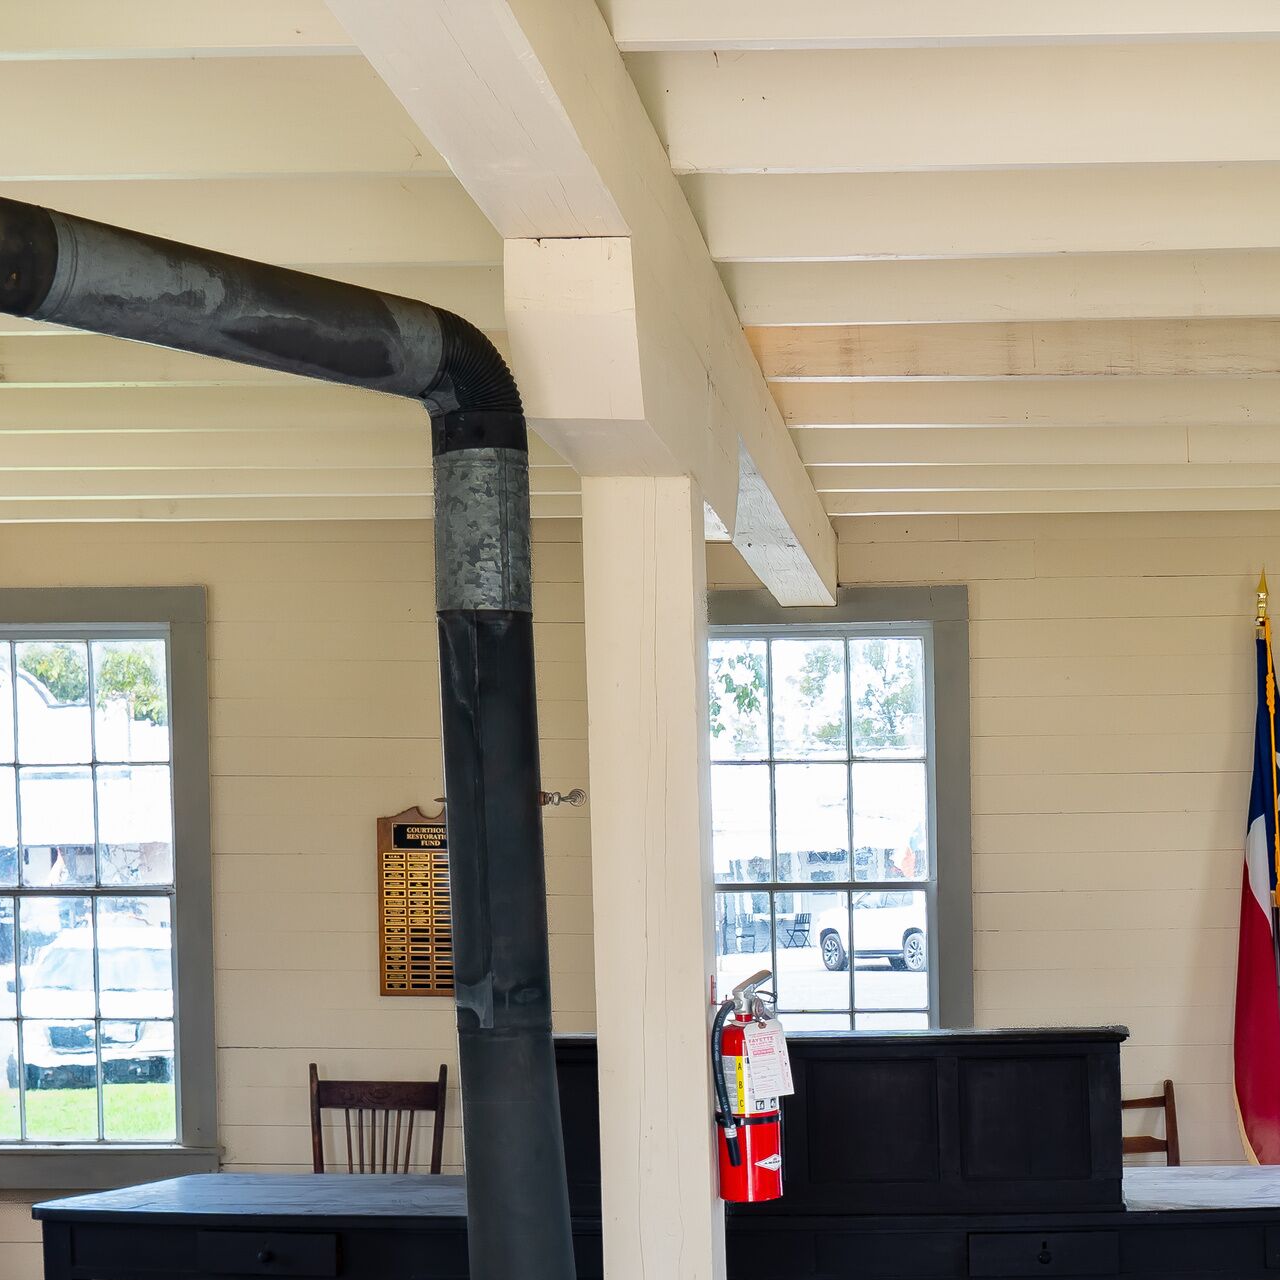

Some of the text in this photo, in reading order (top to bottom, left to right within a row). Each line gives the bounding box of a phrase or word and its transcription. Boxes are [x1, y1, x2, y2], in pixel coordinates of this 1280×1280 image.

[737, 1062, 743, 1071] A
[738, 1080, 743, 1089] B
[739, 1099, 745, 1108] C
